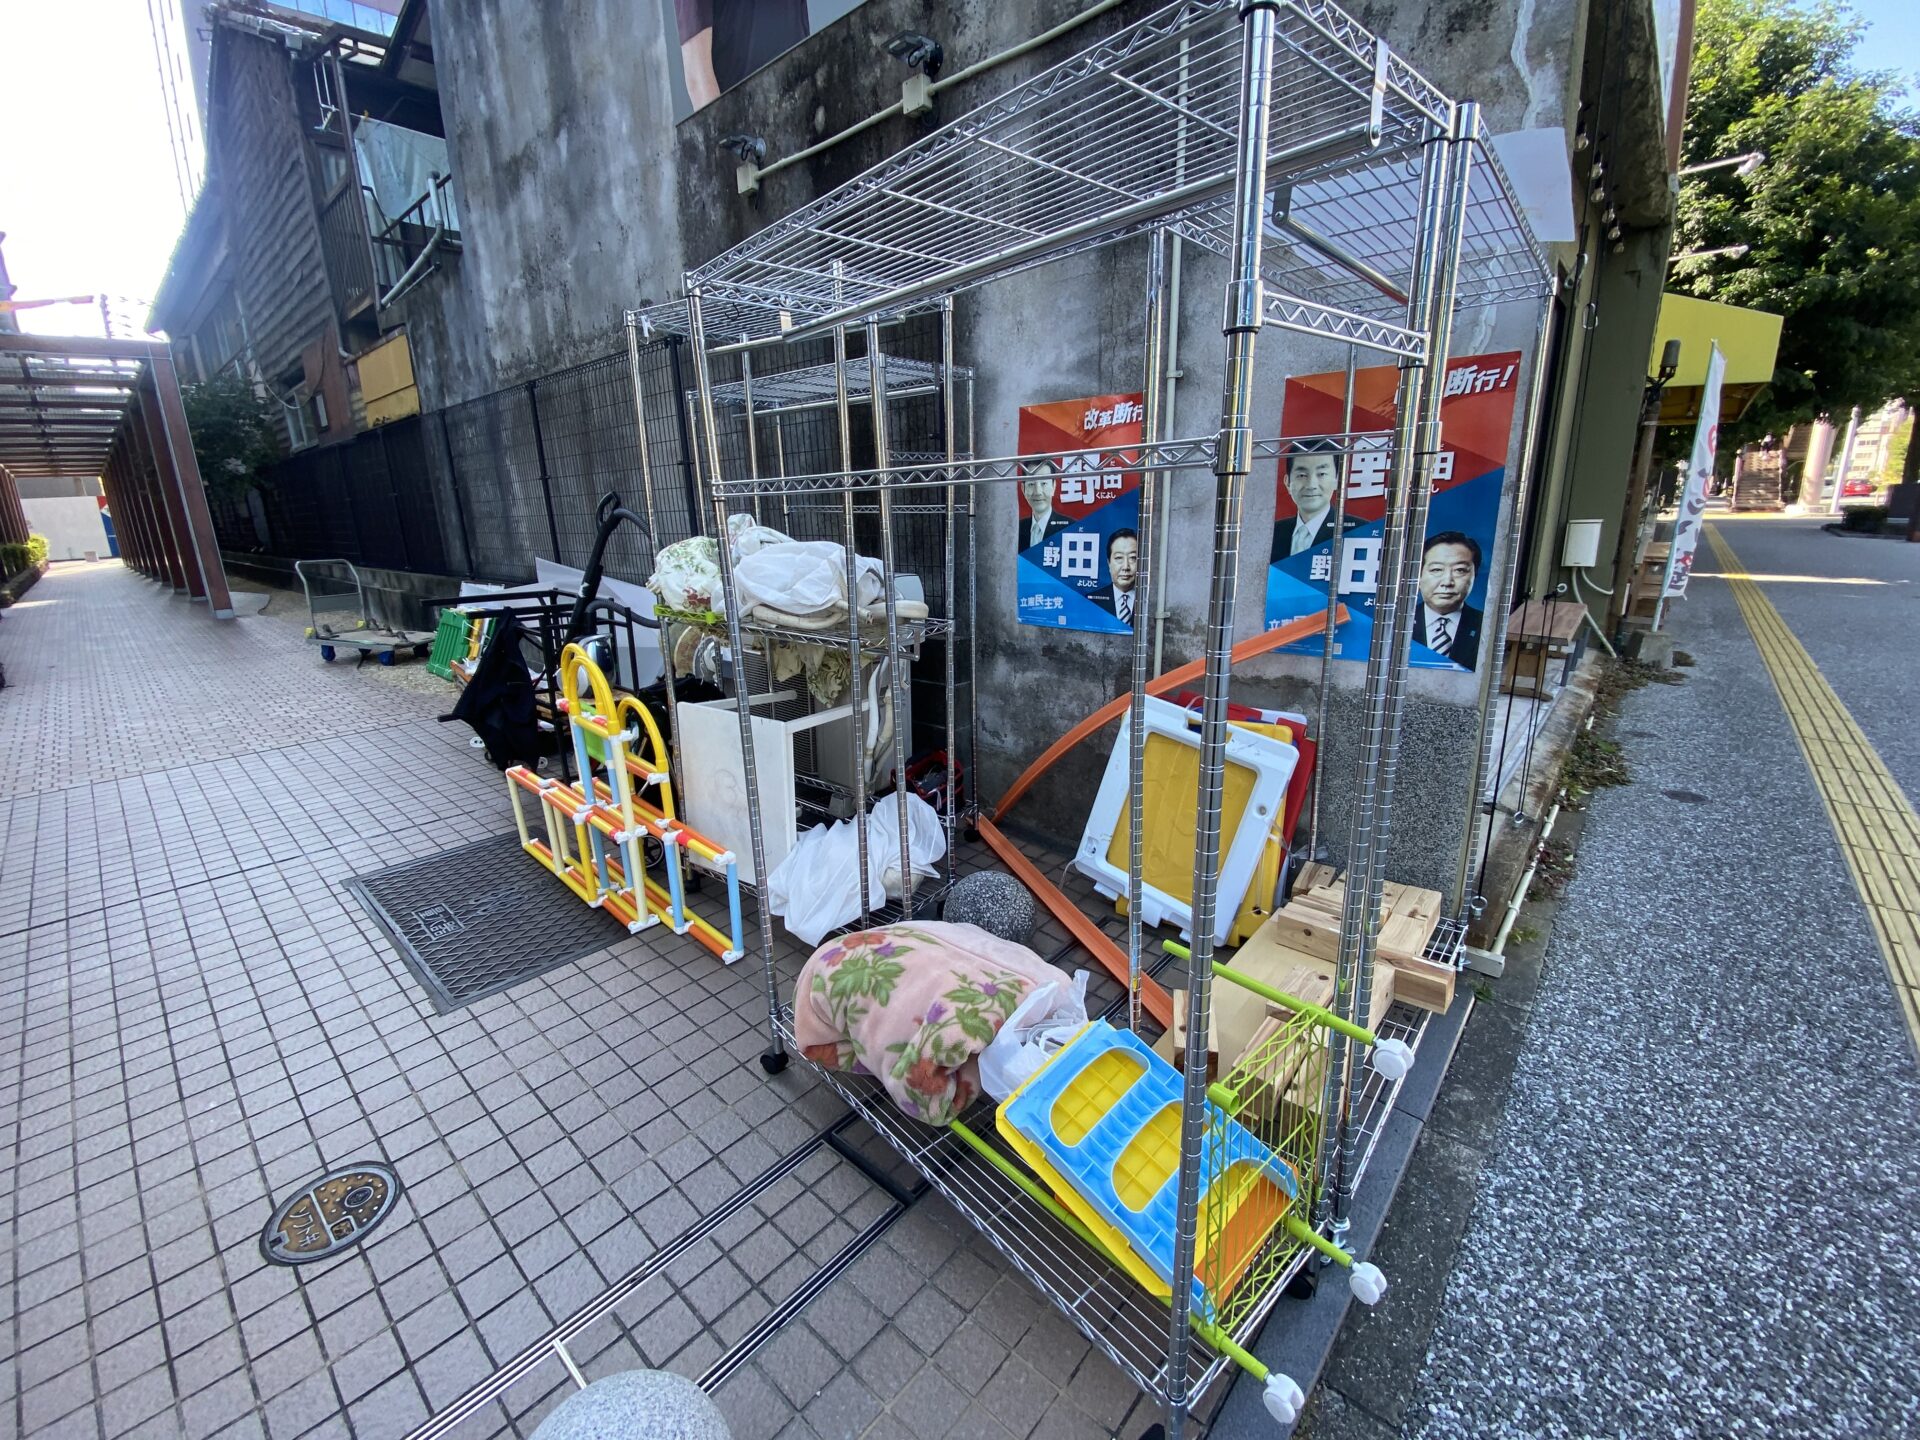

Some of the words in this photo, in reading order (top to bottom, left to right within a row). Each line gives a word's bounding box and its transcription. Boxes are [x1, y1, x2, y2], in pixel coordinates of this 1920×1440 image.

[1084, 401, 1143, 430] 改革断行
[1060, 454, 1122, 504] 野田
[1096, 491, 1116, 499] くによし
[1043, 533, 1100, 579] 野田
[1077, 580, 1098, 588] よしひこ
[1020, 594, 1064, 609] 立憲民主党
